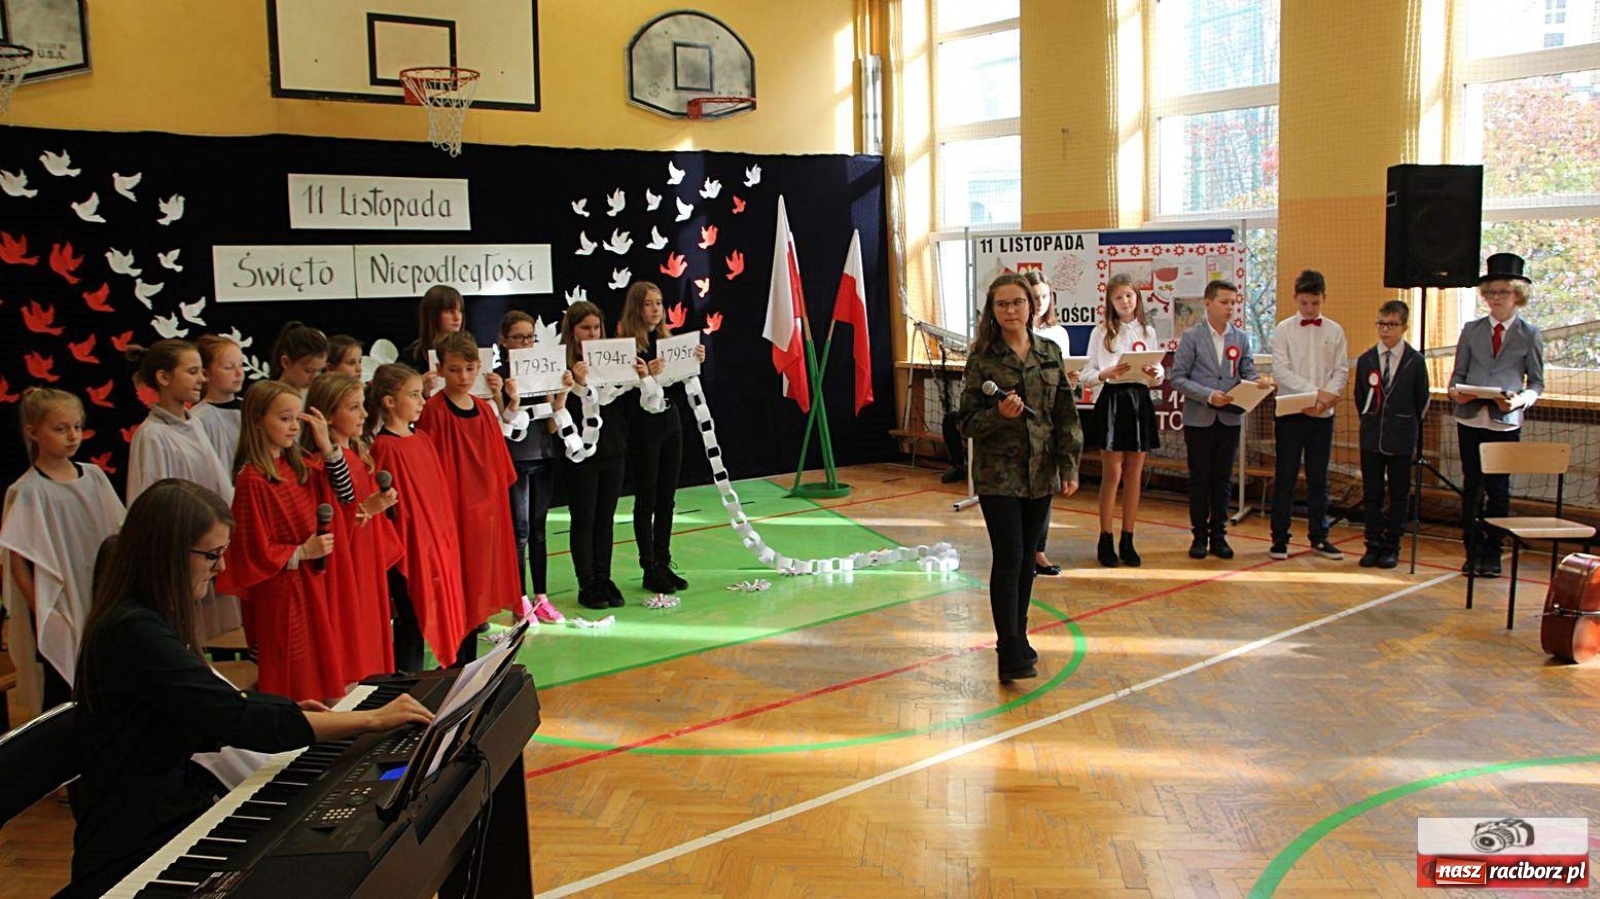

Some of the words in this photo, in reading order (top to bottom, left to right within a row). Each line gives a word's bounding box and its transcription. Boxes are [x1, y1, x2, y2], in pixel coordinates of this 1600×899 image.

[302, 184, 323, 215] 11
[340, 186, 453, 226] Listopada
[980, 239, 993, 253] 11
[1000, 234, 1085, 253] LISTOPADA
[232, 251, 335, 293] Święto
[369, 252, 536, 293] Niepodległości
[513, 357, 561, 376] 1793r.
[586, 350, 631, 367] 1794r.
